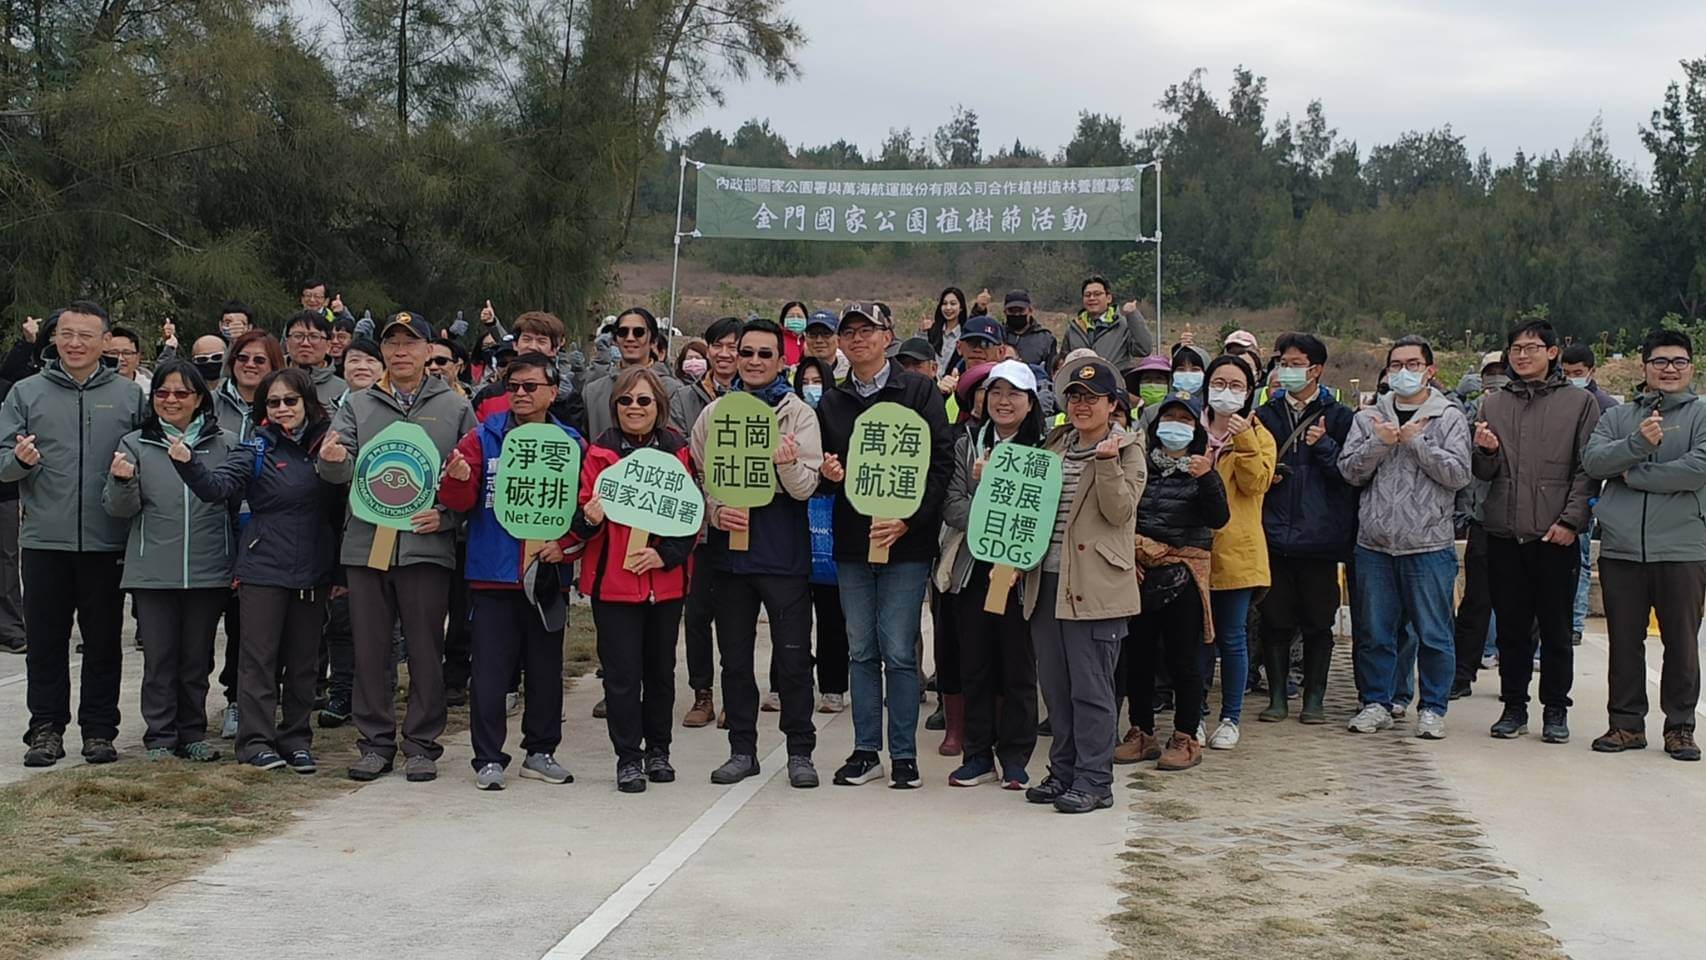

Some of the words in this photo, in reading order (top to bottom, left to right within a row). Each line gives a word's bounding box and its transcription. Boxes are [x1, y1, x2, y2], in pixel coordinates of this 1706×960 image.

[752, 202, 1088, 234] 金門國家公園植樹節活動
[714, 413, 770, 450] 古崗
[860, 421, 922, 458] 萬海
[507, 438, 571, 473] 淨零
[712, 454, 771, 490] 社區
[993, 445, 1053, 481] 永續
[505, 476, 569, 510] 碳排
[623, 458, 685, 493] 內政部
[855, 462, 919, 500] 航運
[374, 505, 415, 517] NATIONAL
[414, 489, 431, 509] PARK
[598, 477, 698, 526] 國家公園署
[990, 476, 1042, 513] 發展
[504, 511, 529, 524] Net
[533, 512, 565, 527] Zero
[984, 509, 1038, 545] 目標
[976, 536, 1033, 565] SDGs
